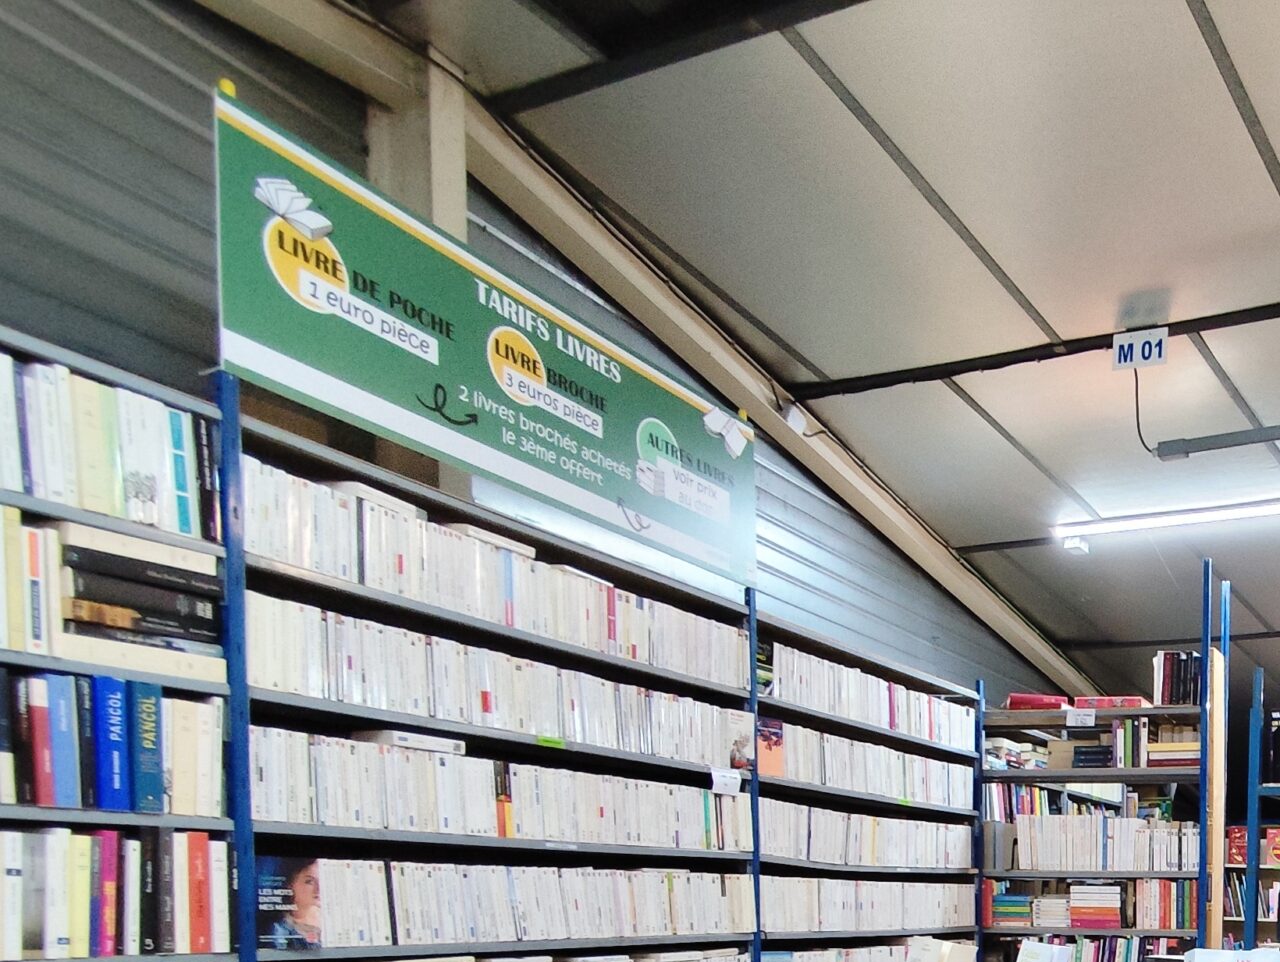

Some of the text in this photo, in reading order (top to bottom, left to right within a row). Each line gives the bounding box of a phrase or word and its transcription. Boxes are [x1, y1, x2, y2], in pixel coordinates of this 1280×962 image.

[277, 230, 456, 342] LIVRE DE POCHE
[308, 282, 430, 354] 1 euro pièce
[474, 278, 622, 384] TARIFS LIVRES
[495, 339, 542, 378] LIVRE
[1118, 338, 1162, 364] M 01
[505, 373, 600, 431] 3 euros pièce
[459, 386, 632, 480] 2 livres brochés achetés
[502, 427, 604, 486] le 3ème offert
[648, 432, 693, 465] AUTRES
[108, 691, 122, 741] PANCOL
[139, 695, 157, 749] PANCOL
